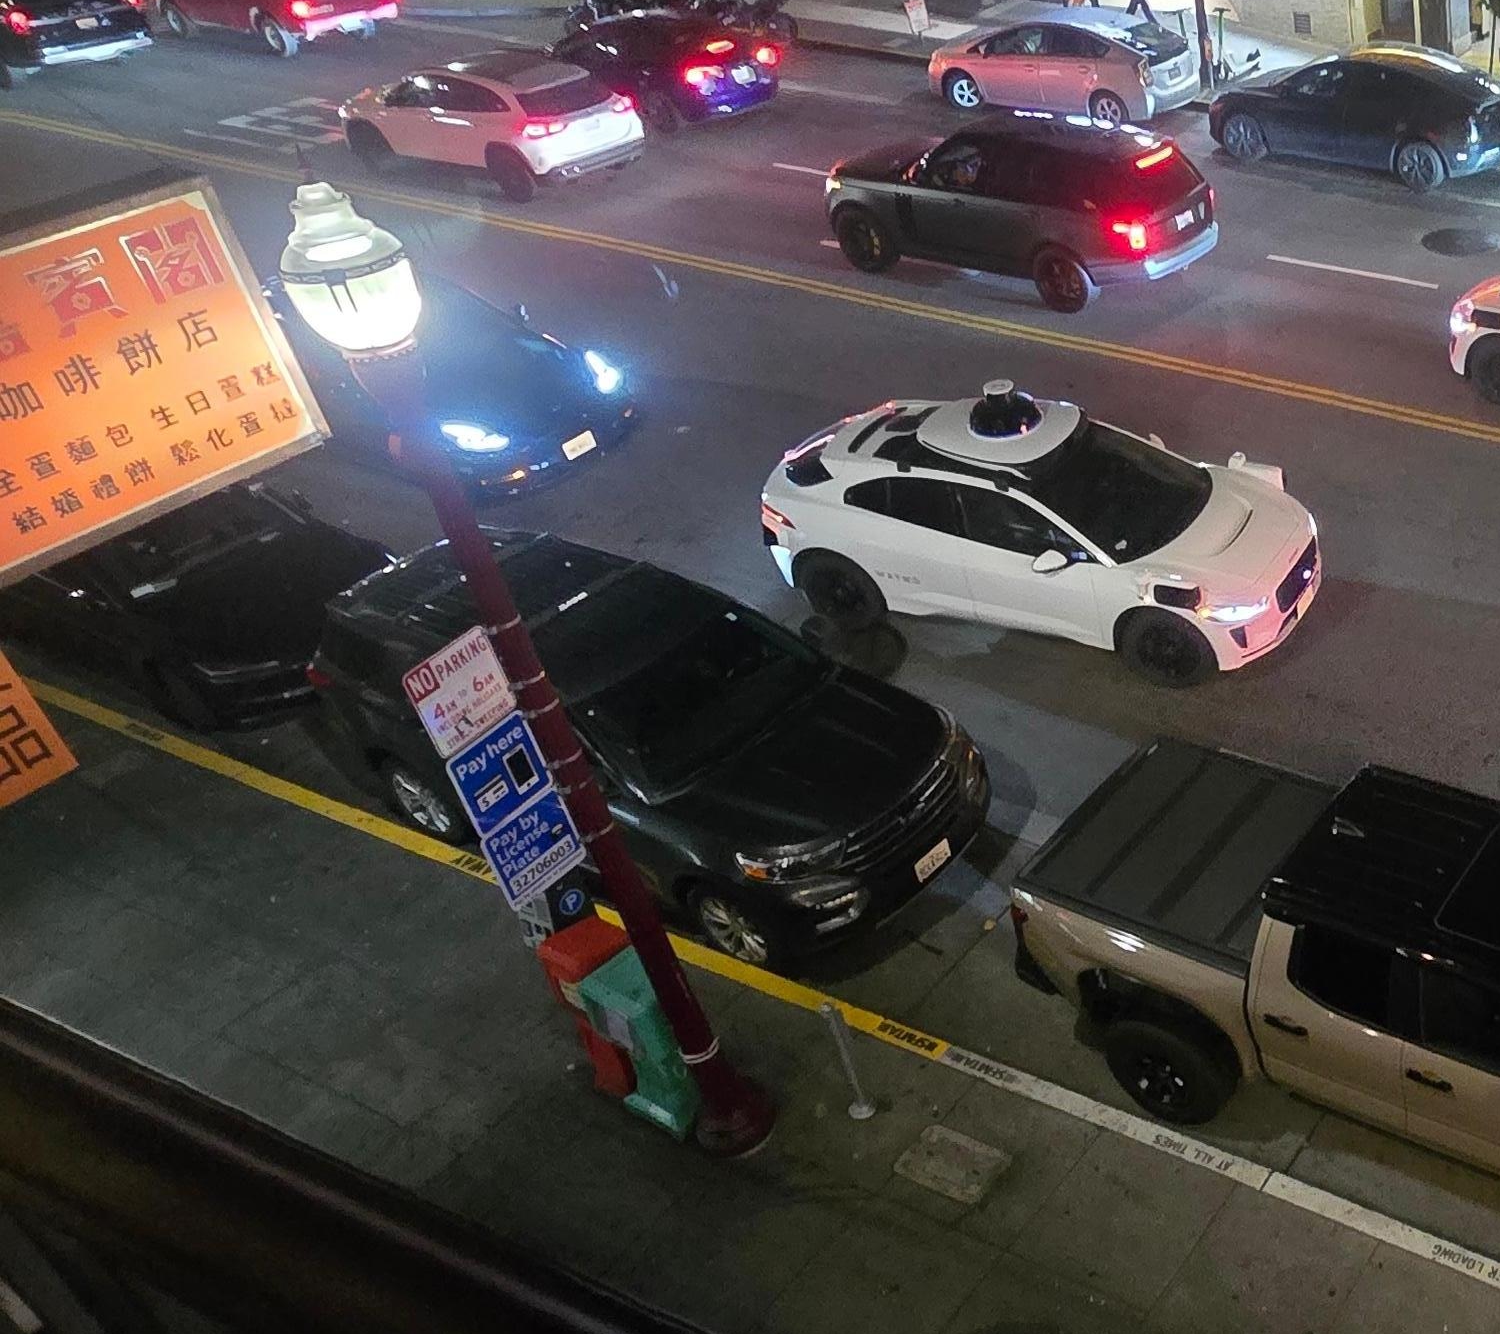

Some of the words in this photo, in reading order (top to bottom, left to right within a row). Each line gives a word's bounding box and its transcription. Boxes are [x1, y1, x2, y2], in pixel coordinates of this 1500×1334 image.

[150, 361, 281, 431] 生日蛋糕
[409, 669, 437, 699] NO
[435, 635, 487, 682] PARKING
[456, 750, 488, 782] Pay
[489, 726, 523, 759] here
[490, 827, 518, 855] Pay
[520, 810, 540, 833] by
[496, 821, 551, 865] License
[502, 846, 541, 880] Plate
[512, 841, 574, 893] 32706003
[1151, 1132, 1190, 1157] TIMES
[1193, 1148, 1216, 1165] ALL
[1216, 1158, 1233, 1173] AT
[1432, 1242, 1485, 1273] LOADING
